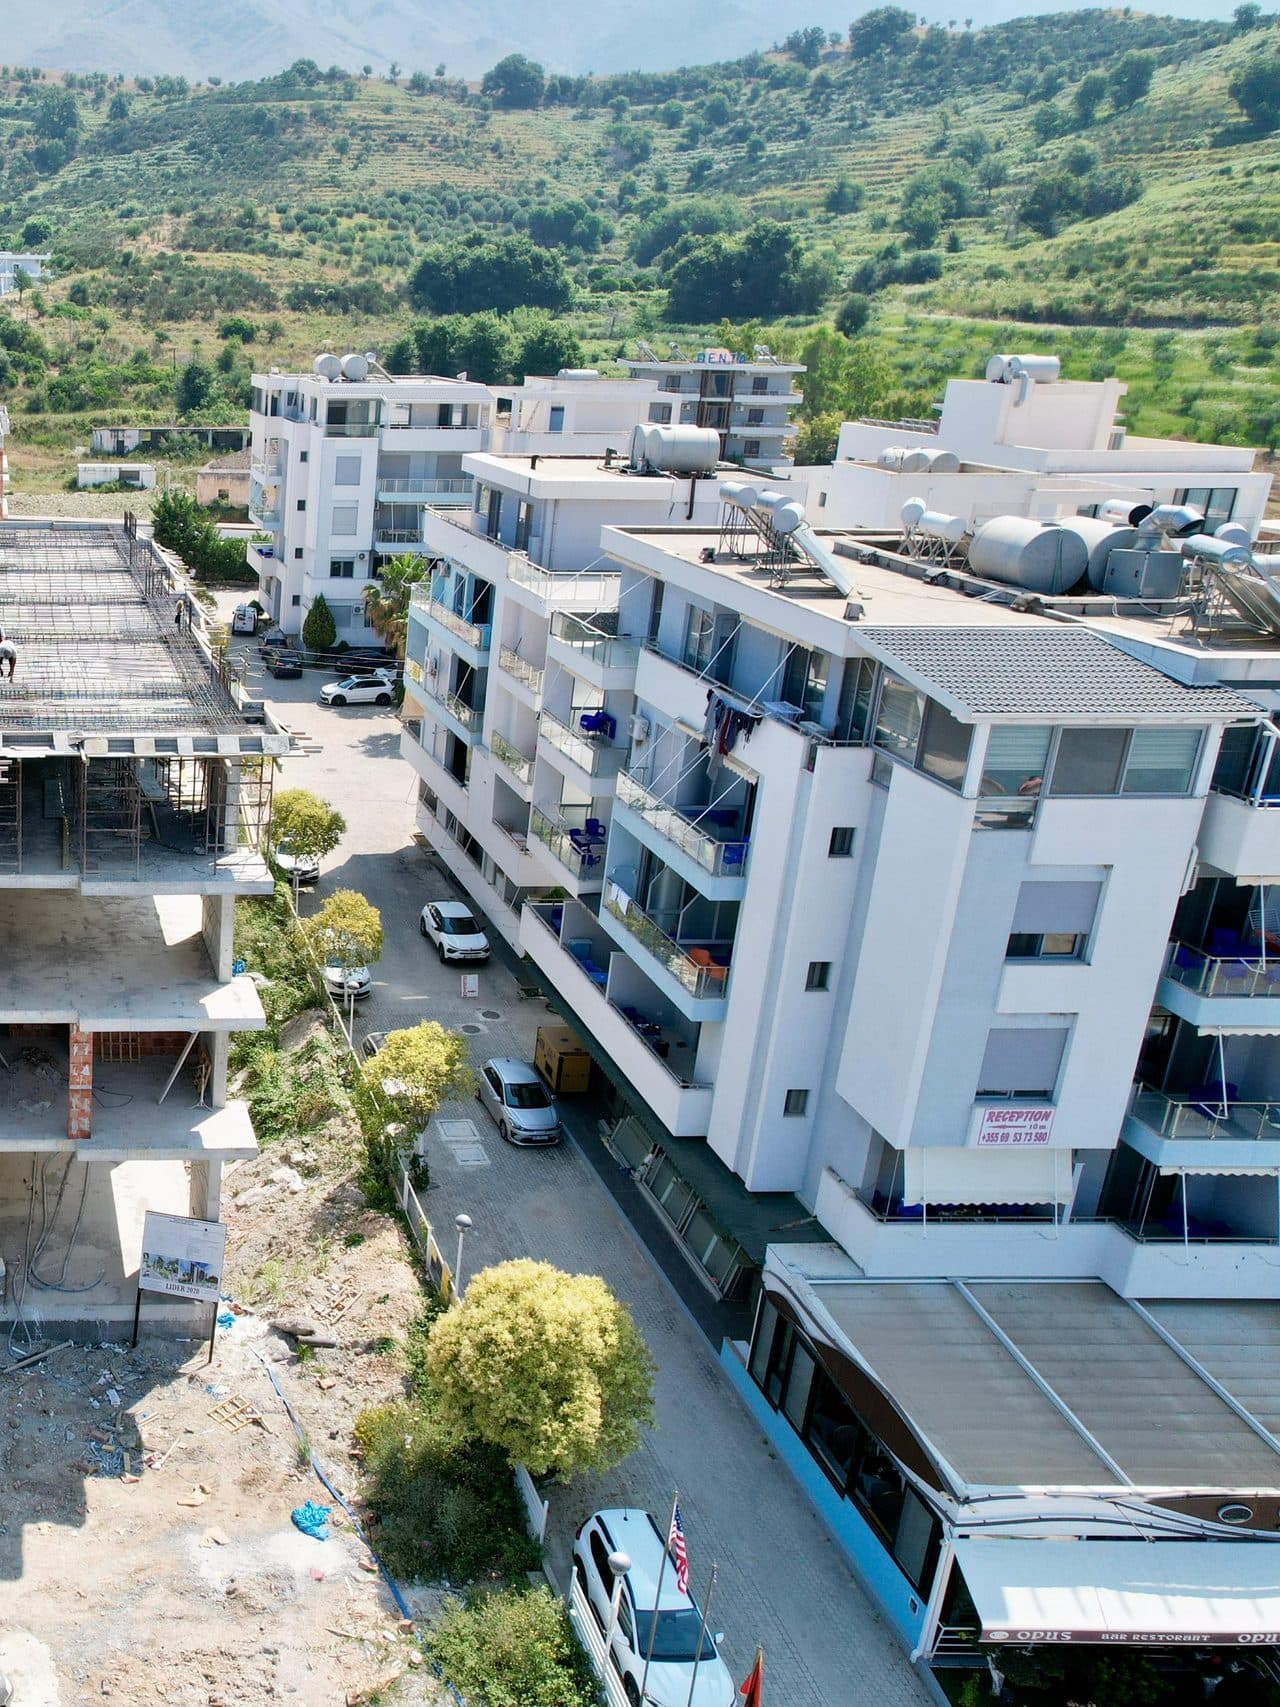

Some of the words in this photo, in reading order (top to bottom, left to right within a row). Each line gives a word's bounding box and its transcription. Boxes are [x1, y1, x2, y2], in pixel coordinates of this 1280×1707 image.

[987, 1110, 1052, 1122] RECEPTION
[982, 1132, 1000, 1142] +355
[1012, 1132, 1022, 1142] 53
[1023, 1132, 1033, 1142] 73
[1017, 1631, 1072, 1640] OPUS
[1133, 1633, 1211, 1641] RESTORANT
[1238, 1633, 1280, 1643] OPU
